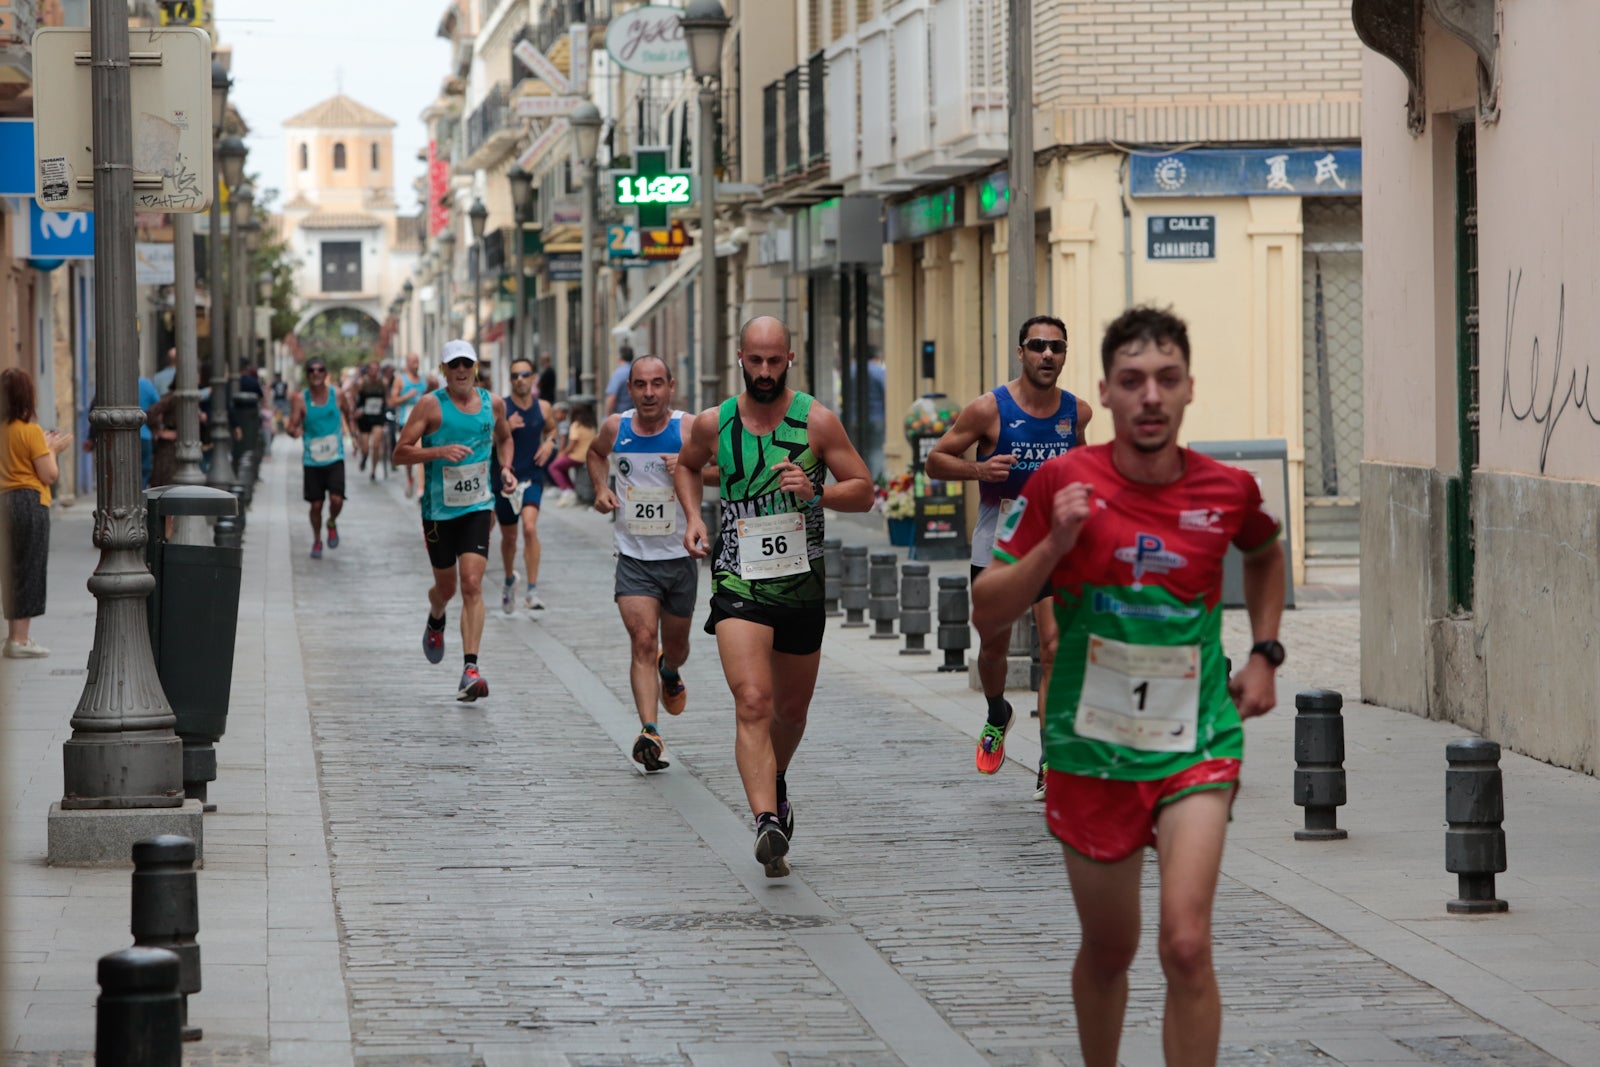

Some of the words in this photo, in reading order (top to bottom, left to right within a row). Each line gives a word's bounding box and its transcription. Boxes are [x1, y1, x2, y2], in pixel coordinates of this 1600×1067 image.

[1264, 153, 1346, 191] 夏氏
[618, 176, 689, 203] 11:32
[1169, 218, 1209, 230] CALLE
[1027, 461, 1044, 471] PE
[454, 477, 480, 492] 483
[635, 503, 664, 519] 261
[761, 535, 788, 556] 56
[1133, 681, 1149, 711] 1
